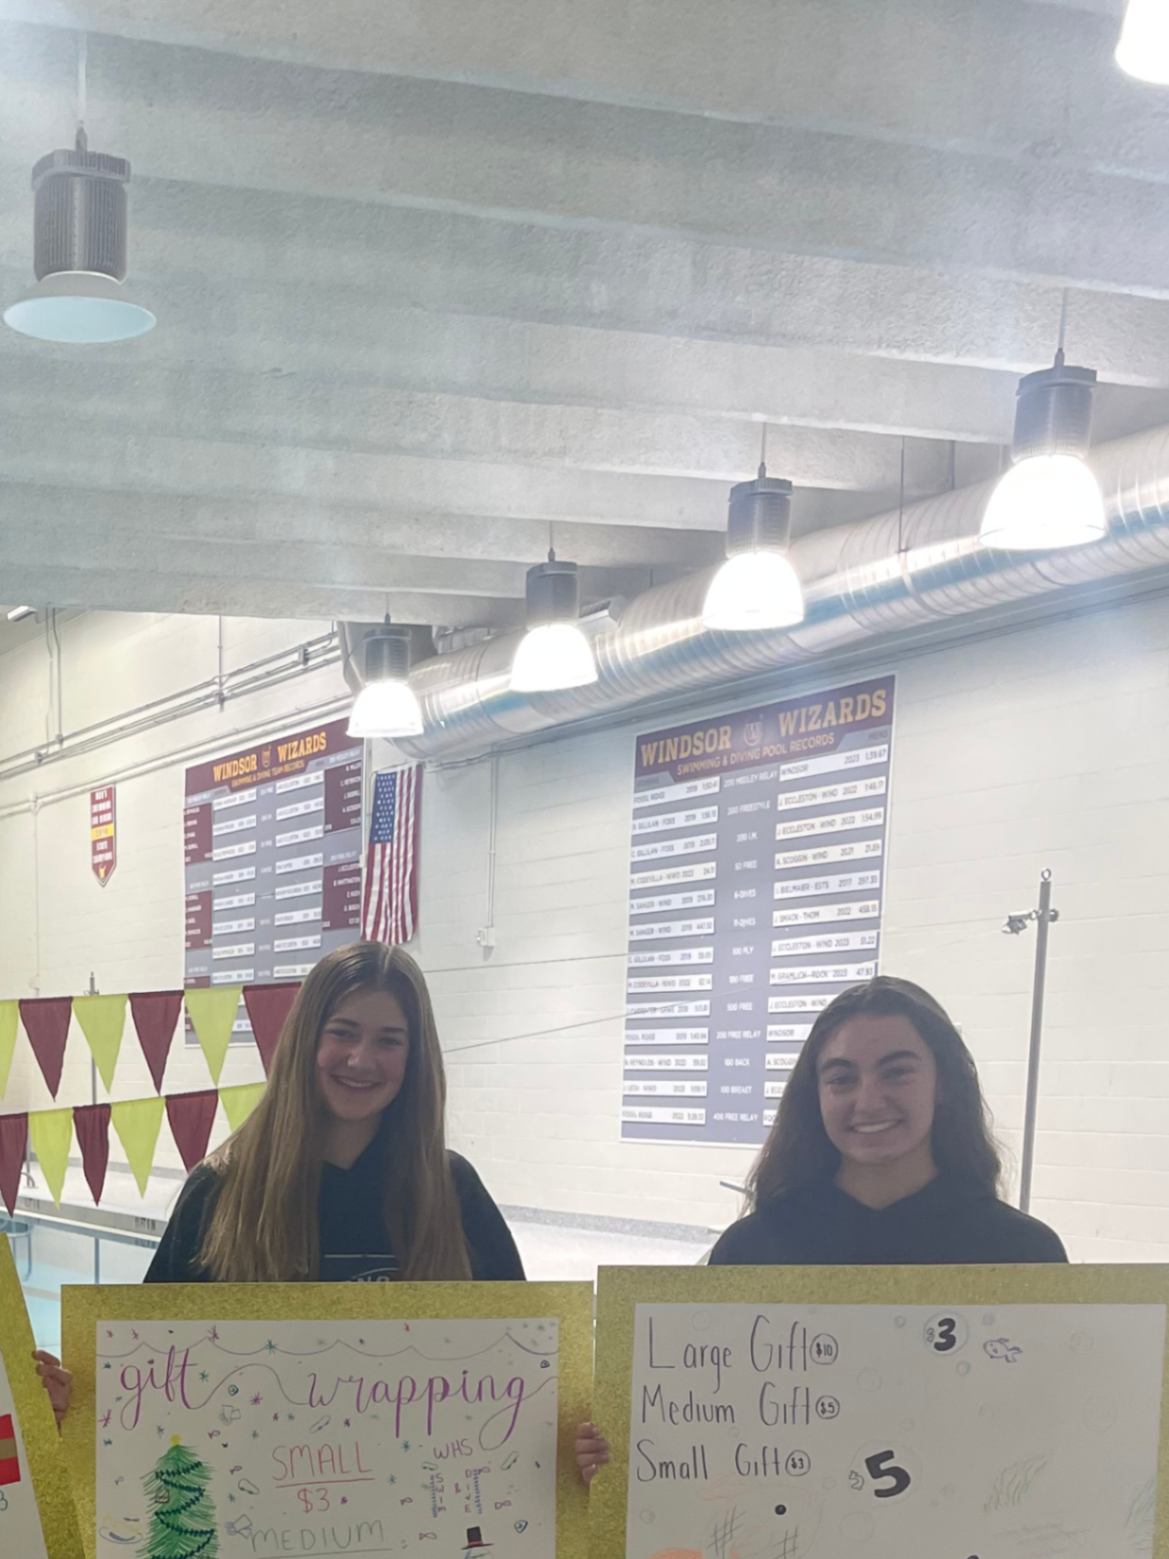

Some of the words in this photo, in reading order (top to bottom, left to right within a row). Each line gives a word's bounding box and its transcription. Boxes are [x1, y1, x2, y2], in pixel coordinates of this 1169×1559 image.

[640, 725, 732, 767] WINDSOR
[778, 688, 887, 737] WIZARDS
[213, 754, 258, 782] WINDSOR
[277, 731, 327, 762] WIZARDS
[676, 756, 721, 776] SWIMMING
[730, 748, 761, 765] DIVING
[762, 742, 788, 758] POOL
[789, 733, 835, 752] RECORDS
[649, 1317, 732, 1394] Large
[750, 1314, 809, 1373] Gift
[120, 1345, 200, 1432] gift
[306, 1369, 526, 1452] wrapping
[642, 1384, 735, 1426] Medium
[759, 1381, 810, 1426] Gift
[272, 1441, 373, 1481] SMALL
[433, 1438, 473, 1459] WHS
[636, 1439, 708, 1482] Small
[735, 1443, 781, 1477] Gift
[297, 1487, 330, 1514] $3
[251, 1519, 385, 1552] MEDIUM
